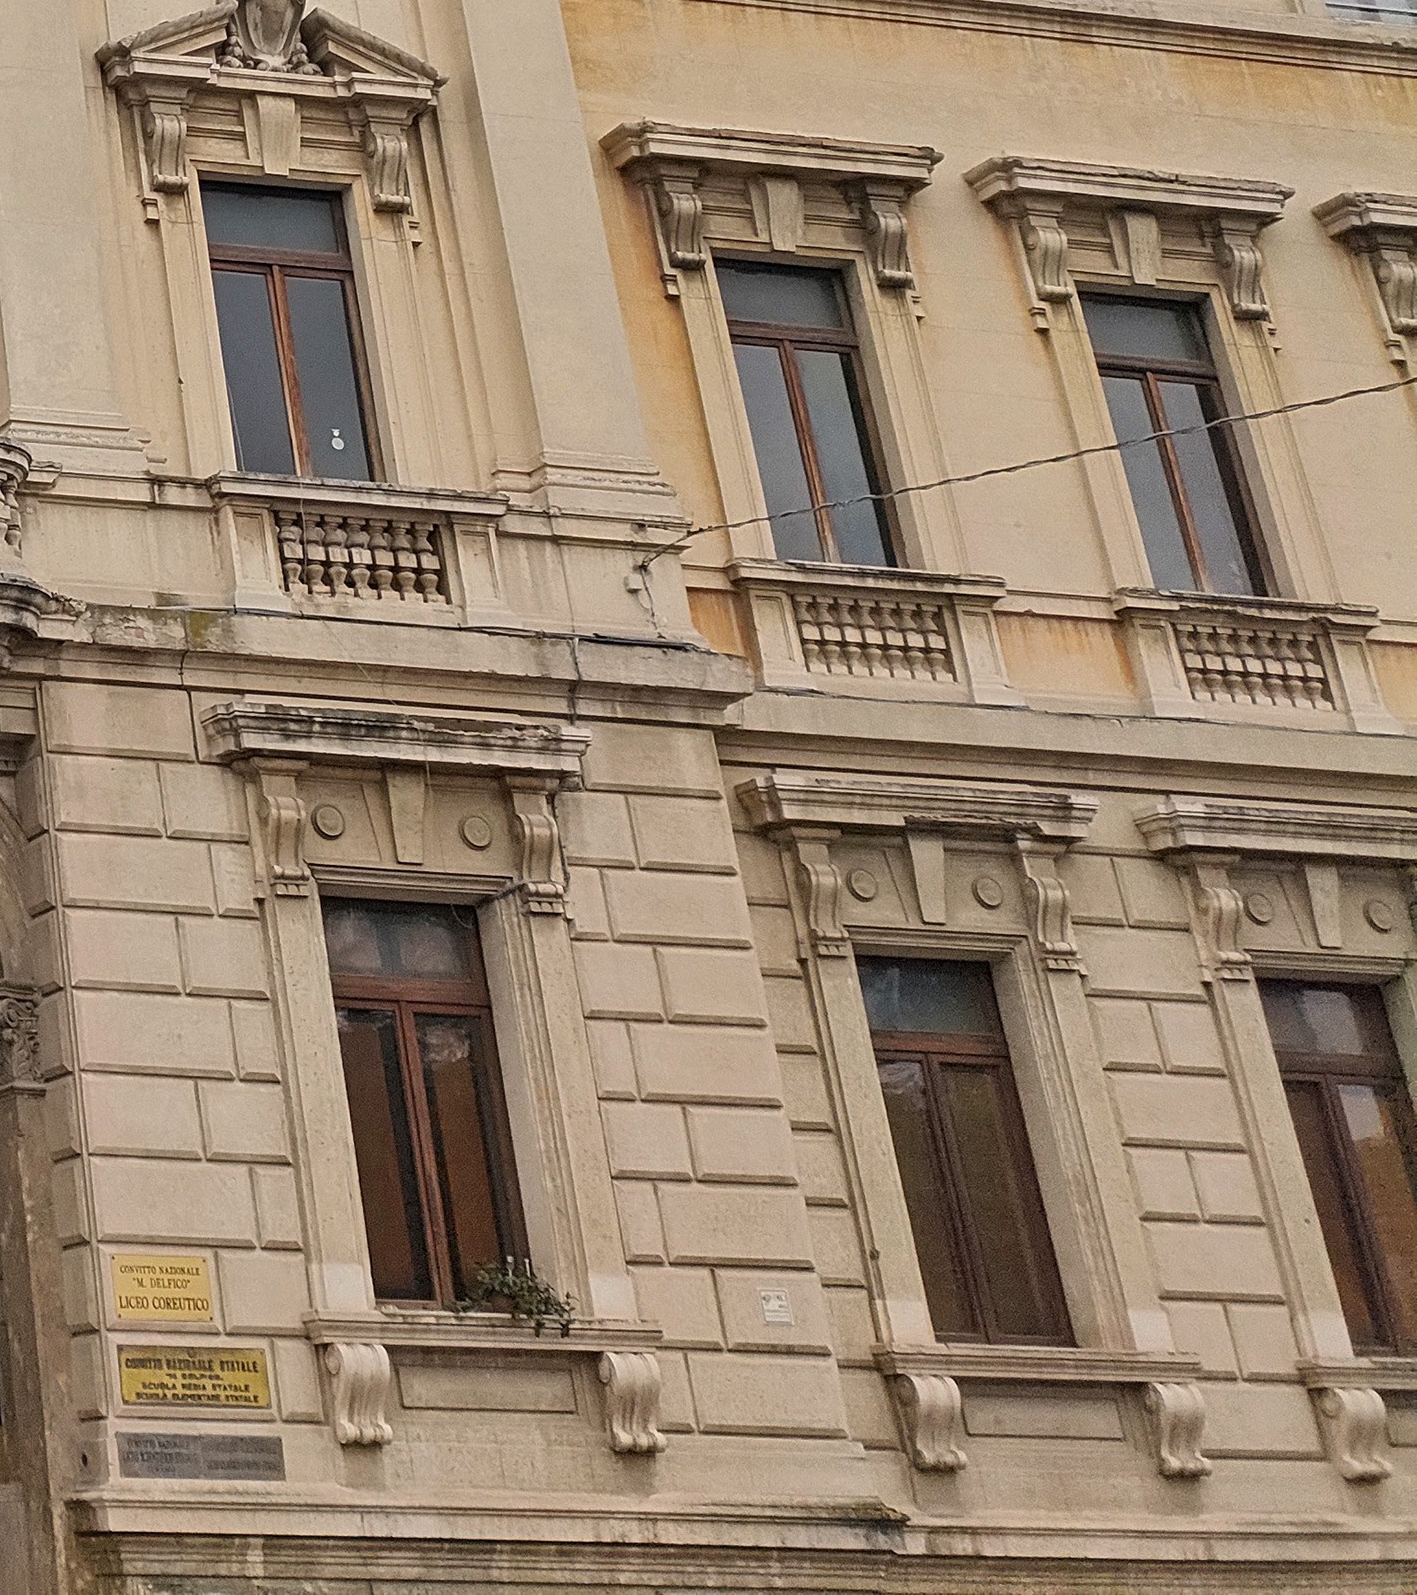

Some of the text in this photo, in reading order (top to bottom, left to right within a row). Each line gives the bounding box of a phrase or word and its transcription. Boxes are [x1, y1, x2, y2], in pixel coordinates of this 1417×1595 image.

[119, 1265, 201, 1277] CONVITTO NAZIONALE
[119, 1295, 210, 1312] LICEO COREUTICO
[219, 1360, 259, 1374] STATALE
[142, 1382, 177, 1391] SCUOLA
[212, 1383, 251, 1393] STATALE
